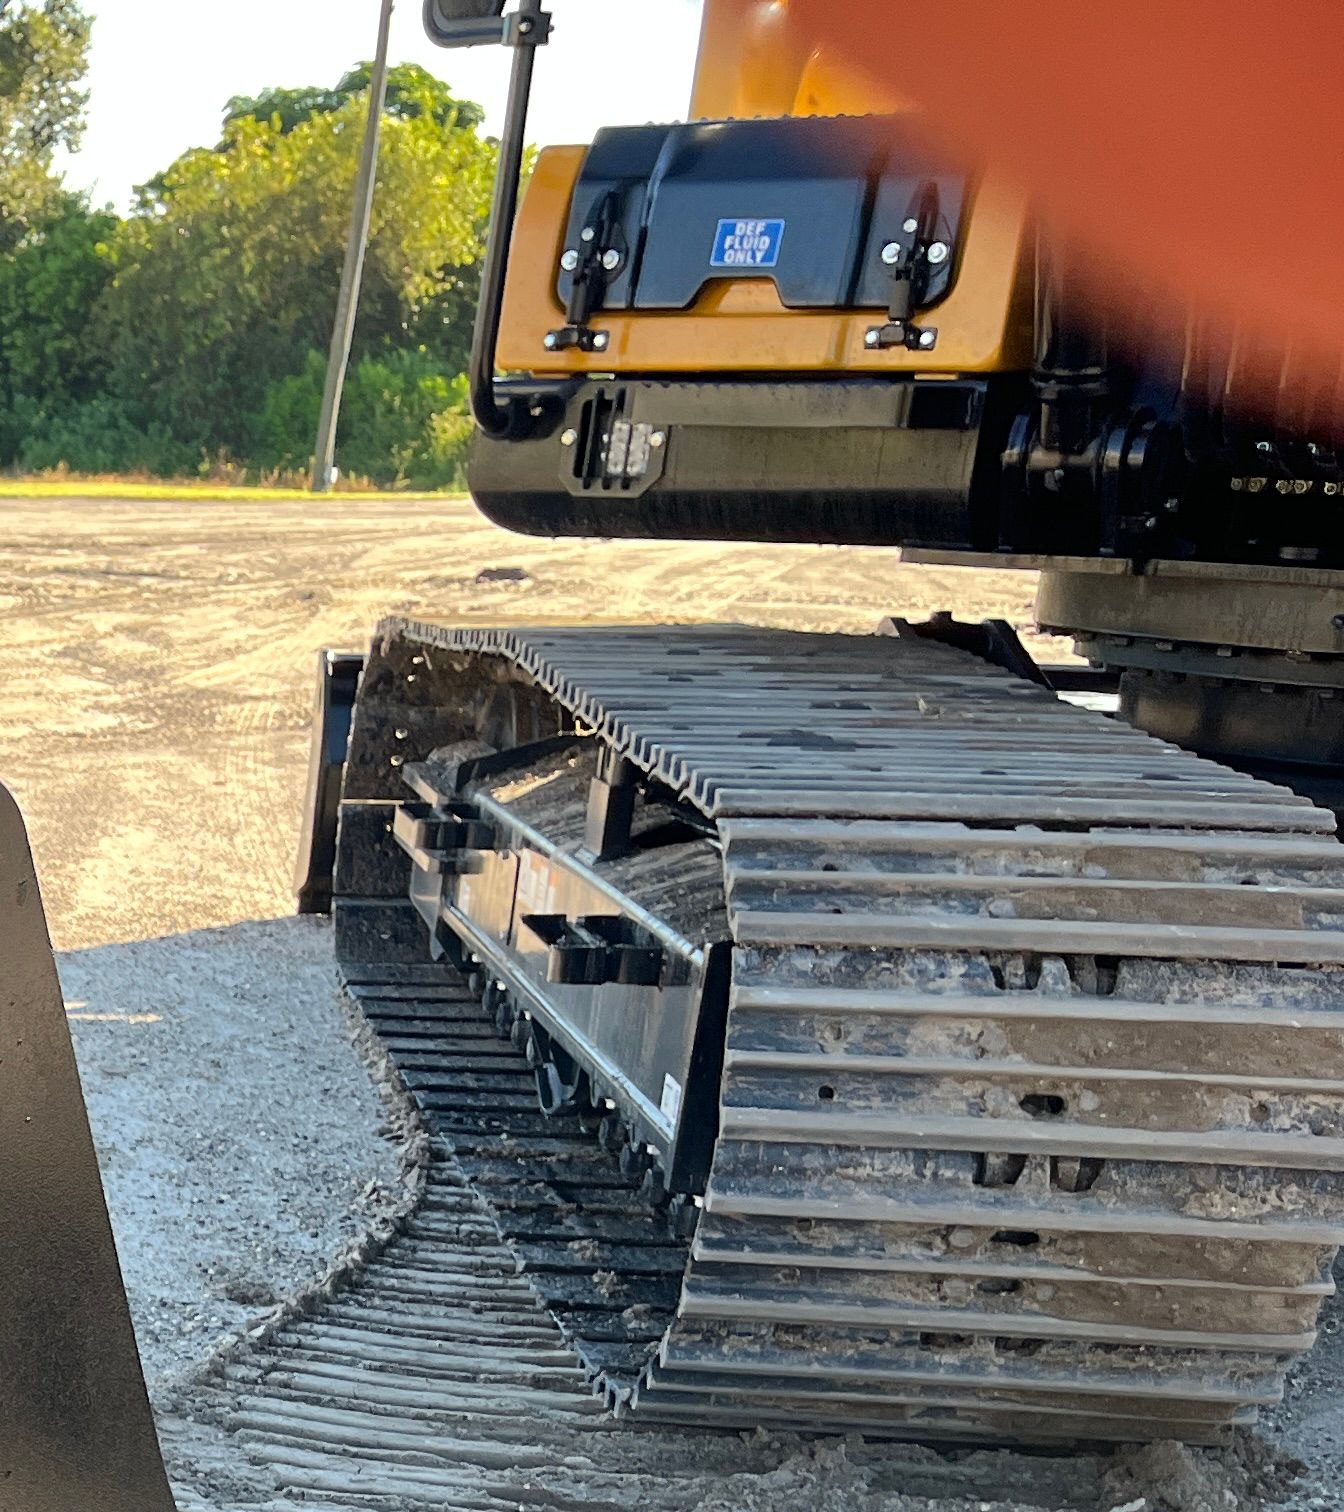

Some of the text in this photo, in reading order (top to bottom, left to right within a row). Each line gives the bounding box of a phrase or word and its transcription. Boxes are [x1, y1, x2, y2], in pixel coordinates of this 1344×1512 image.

[735, 221, 766, 236] DEF
[724, 235, 771, 250] FLUID
[724, 249, 767, 264] ONLY
